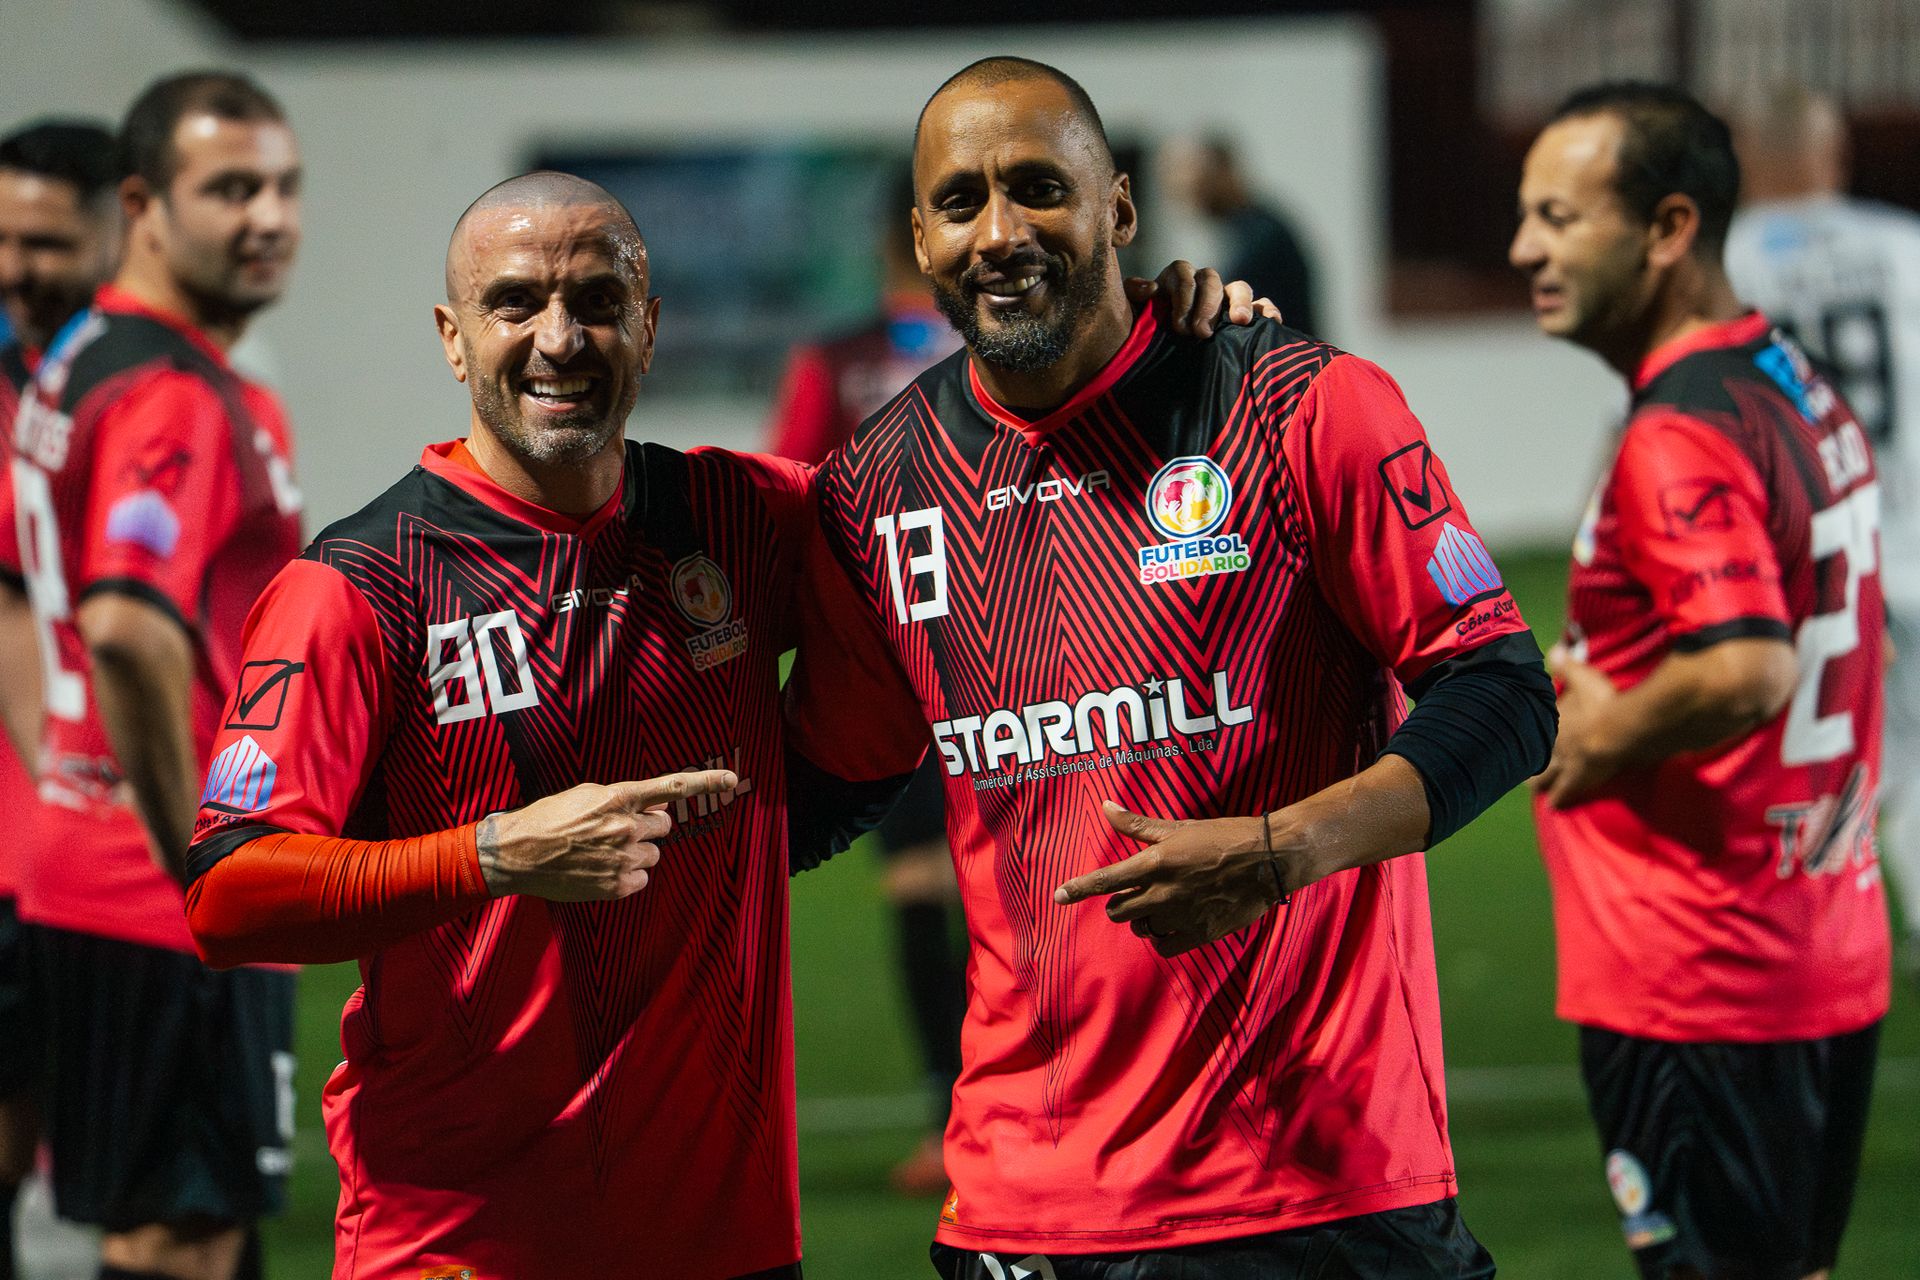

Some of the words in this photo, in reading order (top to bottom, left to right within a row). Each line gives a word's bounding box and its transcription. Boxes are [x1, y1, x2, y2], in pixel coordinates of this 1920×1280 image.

[986, 469, 1110, 511] GIVOVA
[875, 506, 949, 625] 13
[1142, 536, 1245, 566] FUTEBOL
[428, 609, 539, 725] 80
[1016, 772, 1022, 783] e
[1026, 757, 1096, 781] Assistência
[1099, 753, 1113, 769] de
[1189, 738, 1213, 753] Lda
